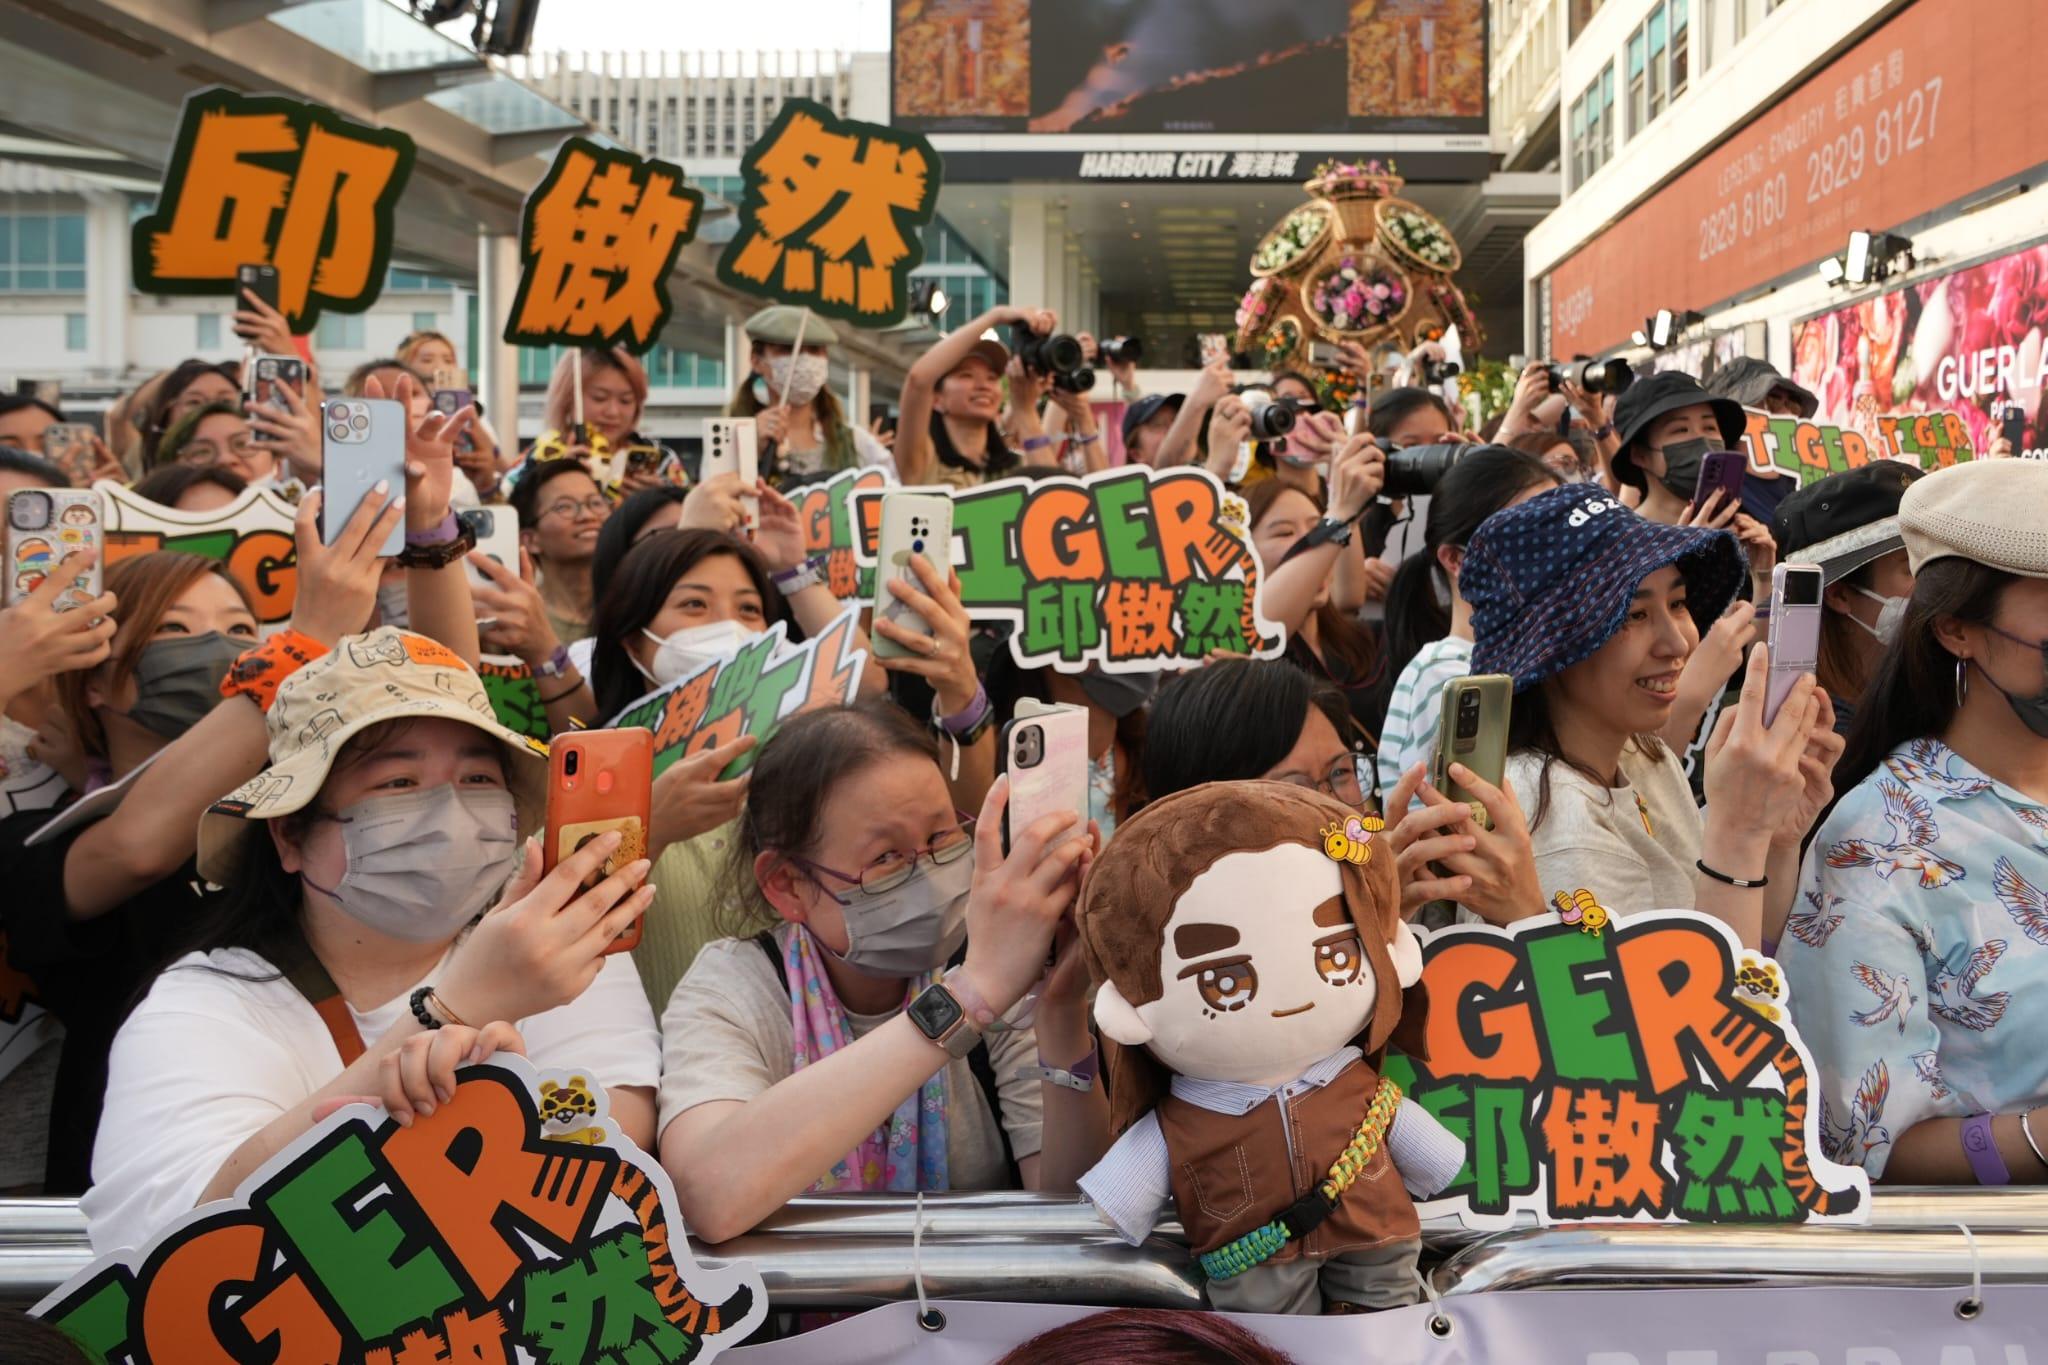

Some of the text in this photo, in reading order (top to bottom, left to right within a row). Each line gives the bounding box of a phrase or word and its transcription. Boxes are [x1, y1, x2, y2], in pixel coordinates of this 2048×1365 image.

[1078, 152, 1177, 177] HARBOUR
[1176, 152, 1227, 177] CITY
[1699, 201, 1737, 261] 2829
[1743, 171, 1788, 238] 8160
[1807, 124, 1865, 204] 2829
[1874, 75, 1943, 166] 8127
[1769, 103, 1825, 164] ENQUIRY
[150, 106, 398, 318] 邱
[516, 149, 694, 344] 傲
[732, 111, 927, 314] 然
[1744, 412, 1871, 473] TIGER
[1877, 412, 1971, 456] TIGER
[857, 473, 1243, 603] IGER
[1025, 577, 1250, 662] 邱傲然
[1381, 926, 1775, 1098] GER
[1418, 1085, 1797, 1217] 邱傲然
